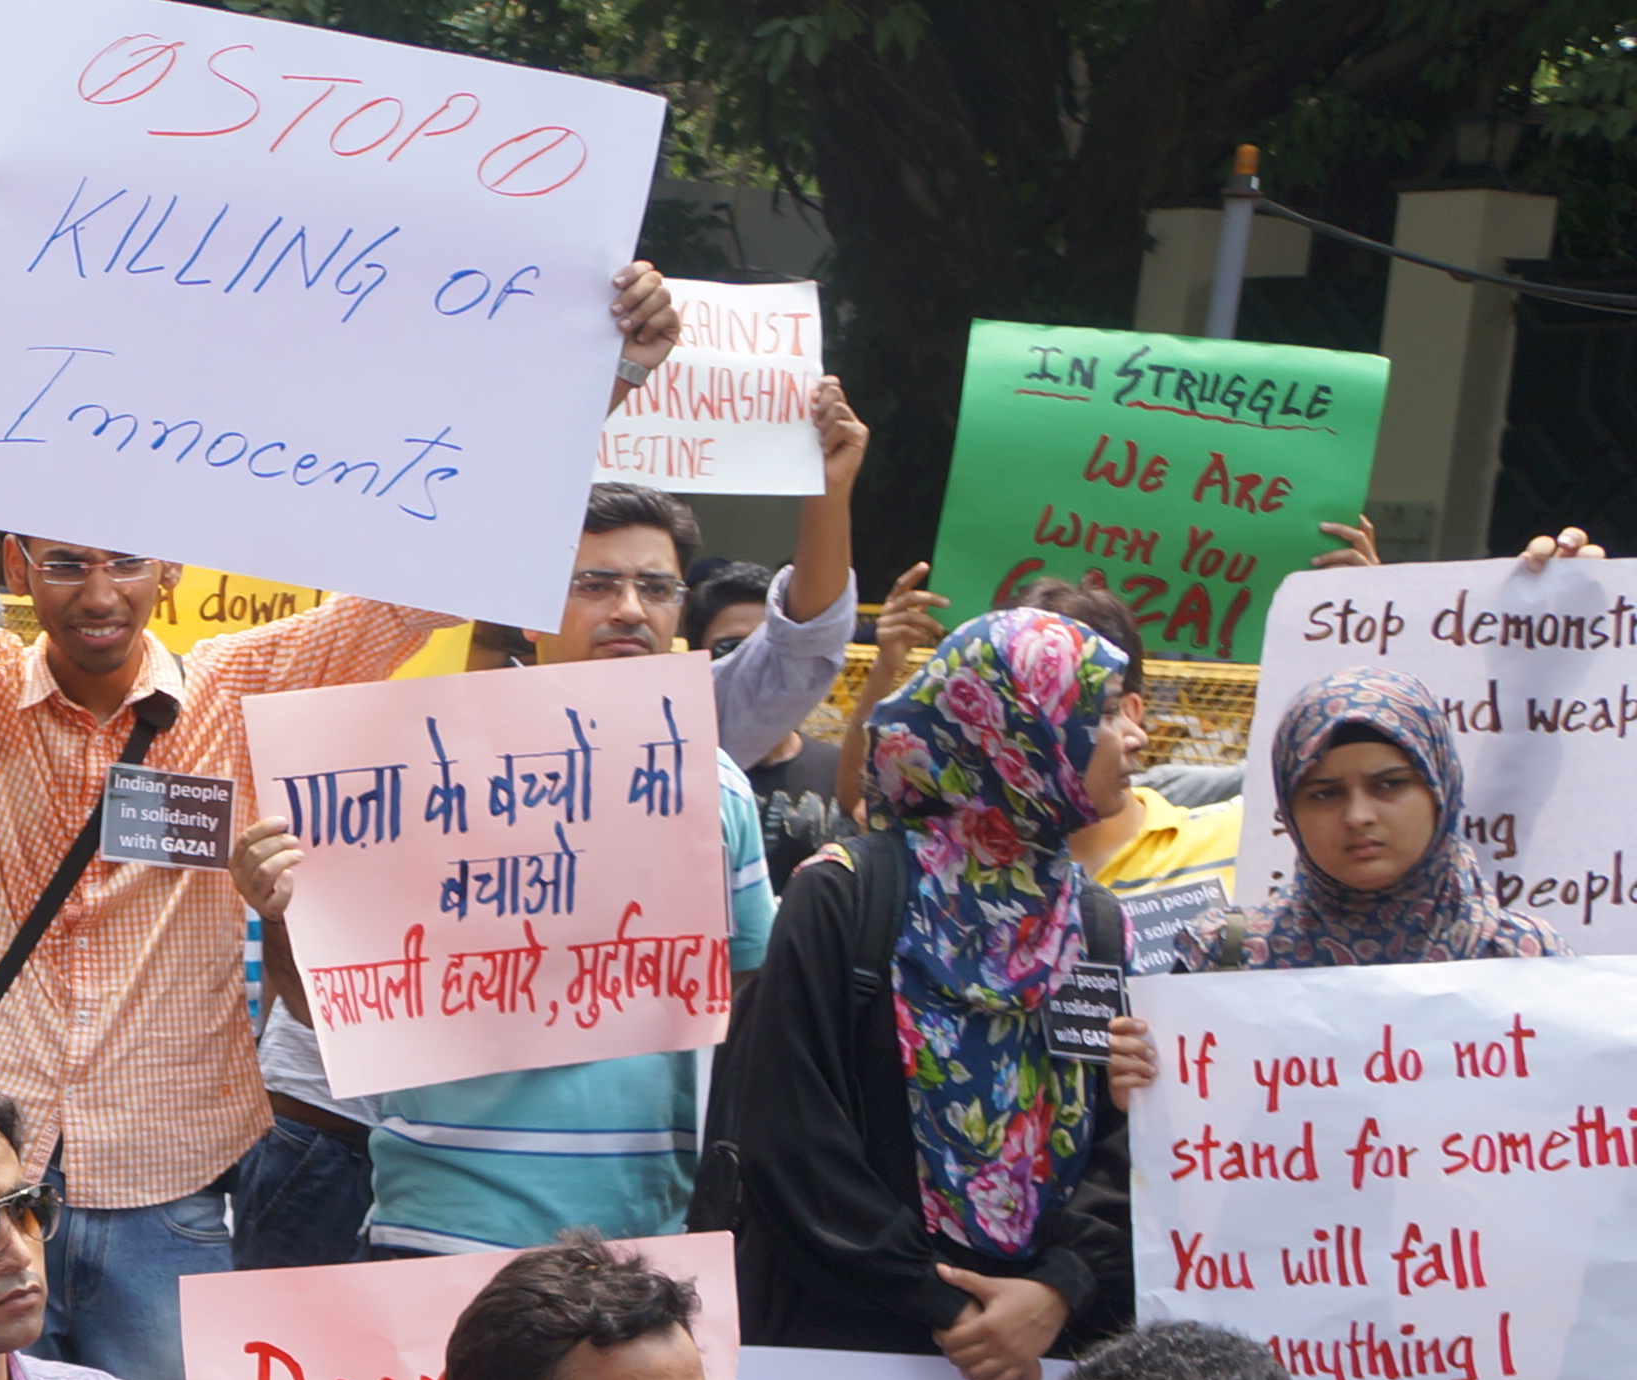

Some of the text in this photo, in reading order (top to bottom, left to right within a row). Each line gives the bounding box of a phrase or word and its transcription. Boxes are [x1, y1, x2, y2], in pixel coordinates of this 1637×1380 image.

[146, 43, 482, 164] STOP
[27, 176, 399, 324] KILLING
[1023, 345, 1334, 424] IN STRUGGLE
[597, 431, 715, 478] LESTINE
[1082, 433, 1294, 515] WE ARE
[1034, 504, 1258, 585] WITH YOU
[1303, 600, 1404, 655] Stop
[113, 773, 229, 806] Indian people
[425, 716, 468, 835] के
[488, 707, 600, 826] बच्चों
[629, 695, 688, 817] को
[118, 831, 216, 858] with GAZA!
[120, 803, 219, 832] in solidarity
[439, 820, 585, 922] बचाओ
[1177, 1012, 1536, 1113] If you do not
[1170, 1117, 1420, 1191] stand for
[1170, 1223, 1488, 1296] You will fall
